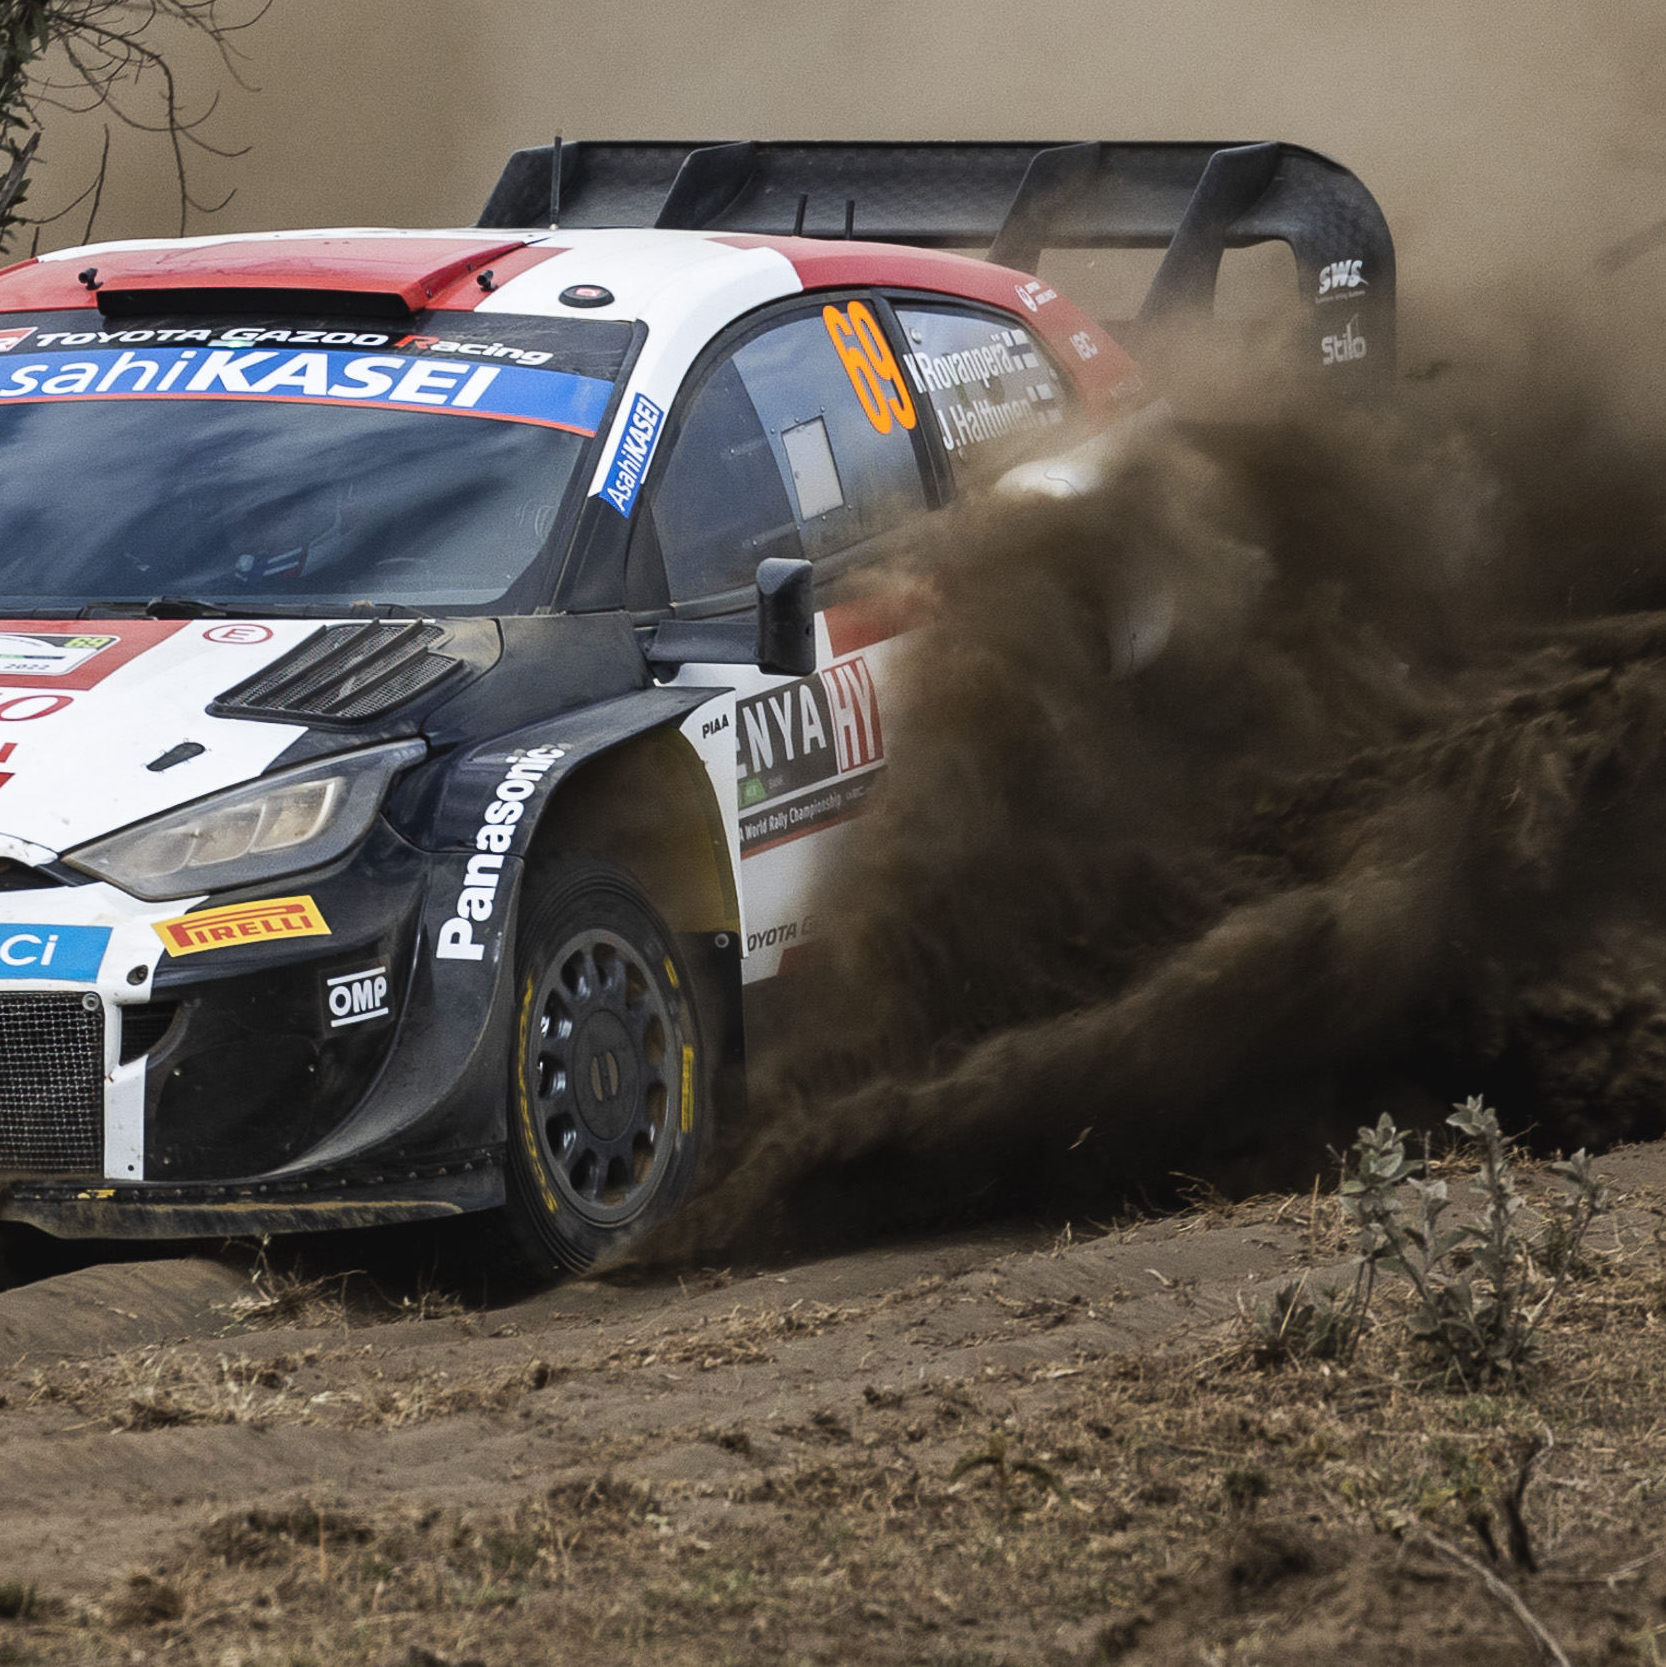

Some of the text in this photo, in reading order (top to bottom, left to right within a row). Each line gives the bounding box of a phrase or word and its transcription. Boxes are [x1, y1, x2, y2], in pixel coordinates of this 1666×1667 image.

[1318, 259, 1368, 294] SWS
[36, 329, 212, 348] TOYOTA
[220, 327, 389, 347] GAZOO
[394, 334, 554, 366] Racing
[1321, 321, 1367, 365] Stilo
[823, 301, 916, 434] 69
[607, 396, 660, 512] AsahiKASEI
[702, 713, 730, 739] PIAA
[823, 657, 876, 771] HY
[744, 817, 768, 841] World
[769, 811, 788, 832] Rally
[789, 792, 842, 824] Championship
[435, 747, 566, 961] Panasonic
[166, 903, 314, 948] PIRELLI
[328, 975, 387, 1017] OMP
